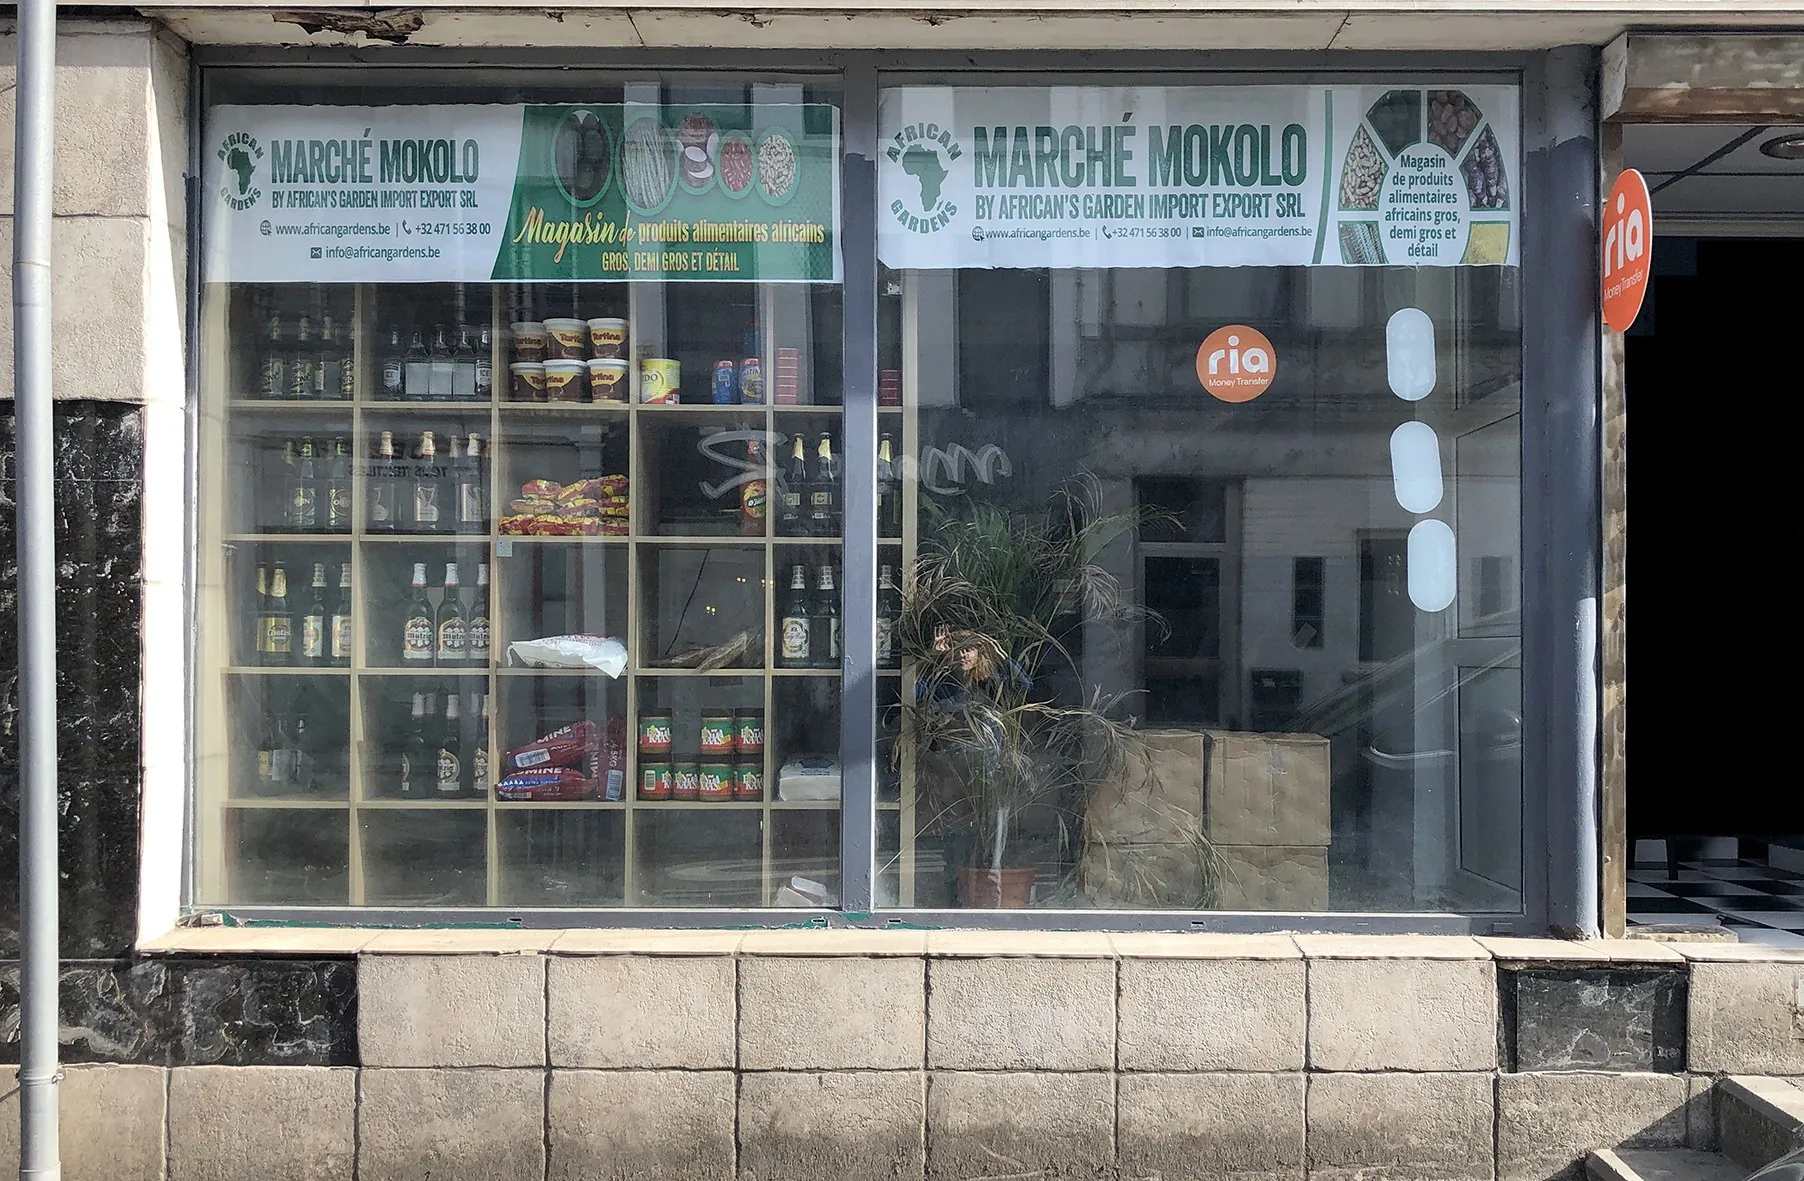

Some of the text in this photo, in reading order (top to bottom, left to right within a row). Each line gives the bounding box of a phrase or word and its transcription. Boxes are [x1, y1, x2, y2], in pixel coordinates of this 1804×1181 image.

[217, 131, 264, 161] AFRICAN
[886, 122, 963, 163] AFRICAN
[973, 112, 1307, 188] MARCHÉ MOKOLO
[271, 128, 480, 184] MARCHÉ MOKOLO
[1400, 154, 1446, 172] Magasin
[1392, 172, 1454, 189] de produits
[220, 186, 262, 211] GARDENS
[272, 190, 478, 208] BY AFRICAN'S GARDEN IMPORT EXPORT SRL
[975, 192, 1306, 220] BY AFRICAN'S GARDEN IMPORT EXPORT SRL
[1388, 189, 1457, 203] alimentaires
[890, 199, 958, 234] GARDENS
[1385, 208, 1460, 224] africains gros,
[275, 222, 491, 238] www.africangardens.be +32 471 56 38 00
[512, 206, 617, 263] Magasin
[618, 209, 636, 247] de
[638, 219, 689, 245] produits
[692, 218, 768, 243] alimentaires
[986, 226, 1313, 242] www.africangardens.be +32 471 56 38 00 info@africangardens.be
[1389, 226, 1456, 242] demi gros et
[1604, 192, 1644, 279] ria
[325, 245, 441, 261] info@africangardens.be
[602, 248, 739, 273] GROS, DEMI GROS ET DÉTAIL
[1408, 243, 1438, 257] détail
[1604, 269, 1644, 302] Money Transfer
[1208, 335, 1269, 375] ria
[643, 373, 659, 383] DO
[1208, 376, 1270, 388] Money Transfer
